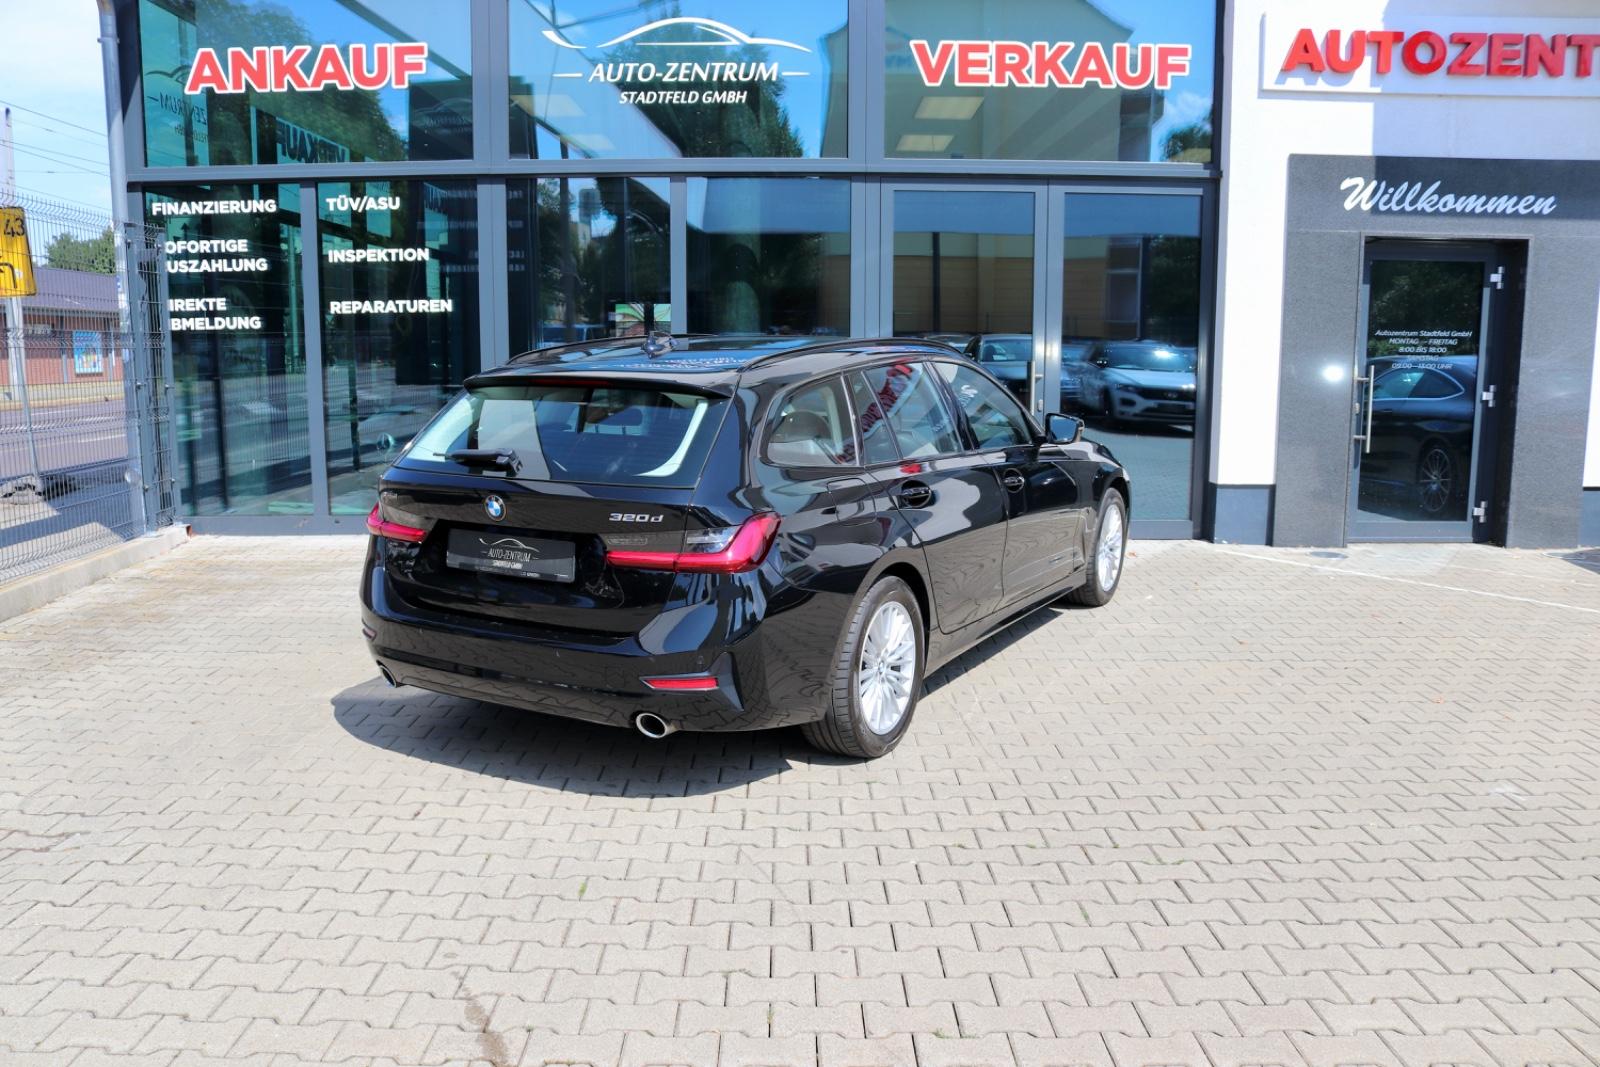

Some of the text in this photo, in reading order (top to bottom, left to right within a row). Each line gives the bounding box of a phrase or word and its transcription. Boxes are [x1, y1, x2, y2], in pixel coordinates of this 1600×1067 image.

[1281, 28, 1600, 78] AUTOZENT
[184, 42, 428, 94] ANKAUF
[588, 62, 779, 83] AUTO-ZENTRUM
[910, 41, 1192, 90] VERKAUF
[619, 91, 747, 104] STADTFELD GMBH
[1340, 176, 1557, 215] Willkommen
[151, 199, 277, 216] FINANZIERUNG
[326, 195, 401, 213] TÜV/ASU
[3, 217, 25, 237] 43
[165, 239, 249, 254] OFORTIGE
[328, 248, 430, 263] INSPEKTION
[167, 258, 268, 273] USZAHLUNG
[169, 298, 227, 312] IREKTE
[330, 299, 453, 315] REPARATUREN
[170, 316, 261, 331] BMELDUNG
[609, 513, 664, 523] 320d
